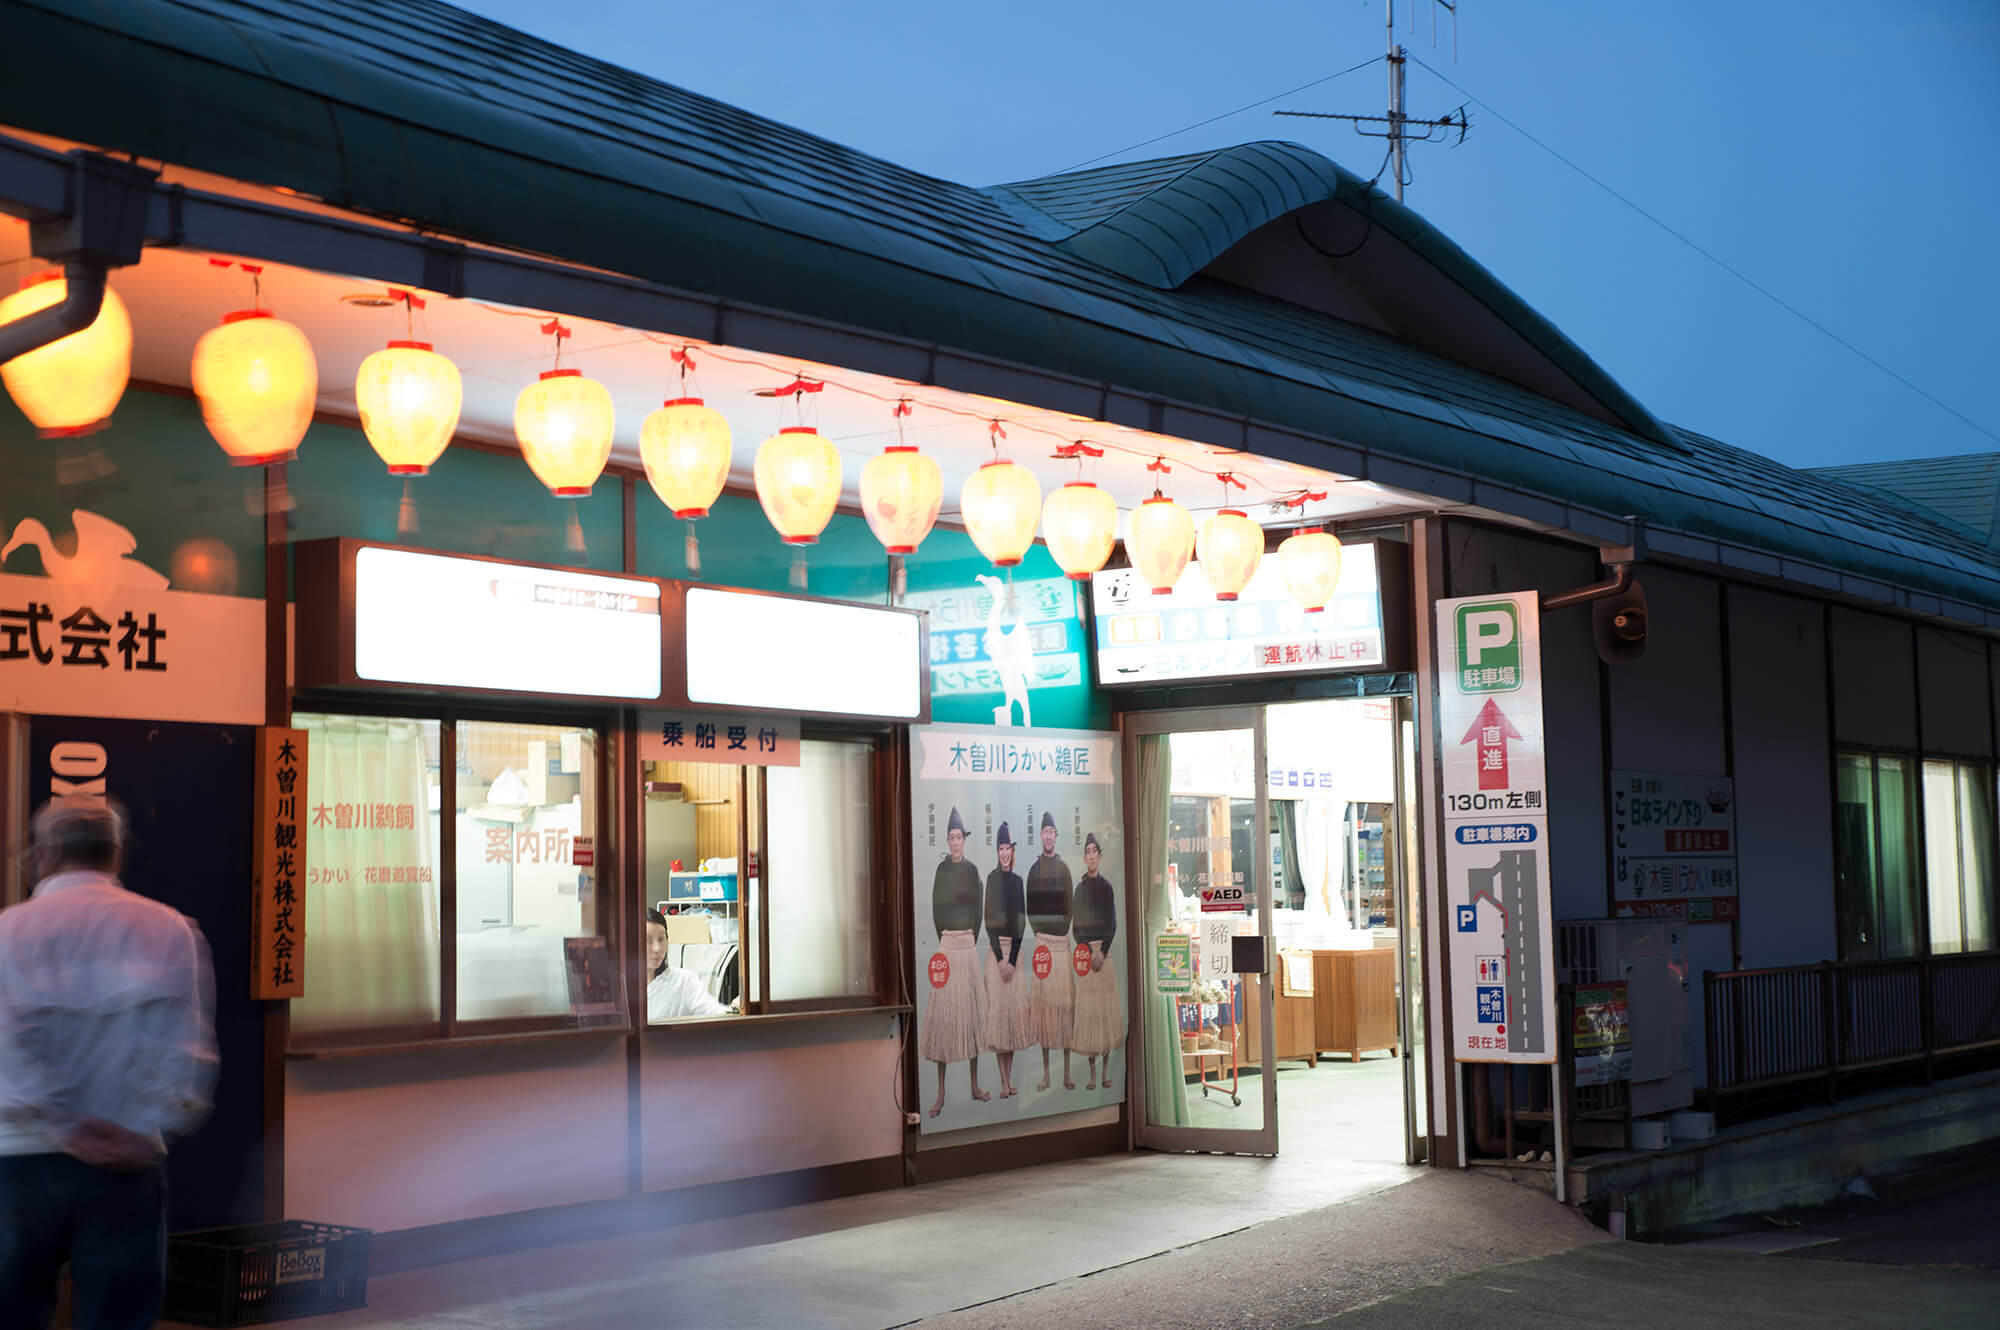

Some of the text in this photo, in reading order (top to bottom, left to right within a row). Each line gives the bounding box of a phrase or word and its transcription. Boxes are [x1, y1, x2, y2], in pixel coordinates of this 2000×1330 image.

[0, 602, 167, 672] 式会社
[1465, 610, 1513, 665] P
[1263, 640, 1368, 665] 運航休止中
[1464, 666, 1515, 688] 駐車場
[662, 721, 778, 752] 乗船受付
[1481, 726, 1503, 770] 直進
[950, 741, 1091, 779] 木曽川うかい鵜匠
[1448, 790, 1541, 812] 130m左側
[1631, 798, 1702, 827] 日本ライン下り
[312, 802, 414, 831] 木曽川鵜飼
[485, 827, 570, 865] 案内所
[1463, 827, 1530, 842] 駐車場案内
[1615, 791, 1628, 882] ここは
[272, 738, 298, 988] 木曽川観光株式会社
[1214, 889, 1242, 900] AED
[1461, 910, 1474, 927] P
[1480, 993, 1491, 1016] 観光
[1491, 989, 1503, 1021] 木曽川
[1467, 1035, 1507, 1050] 現在地
[280, 1251, 321, 1273] BeBox
